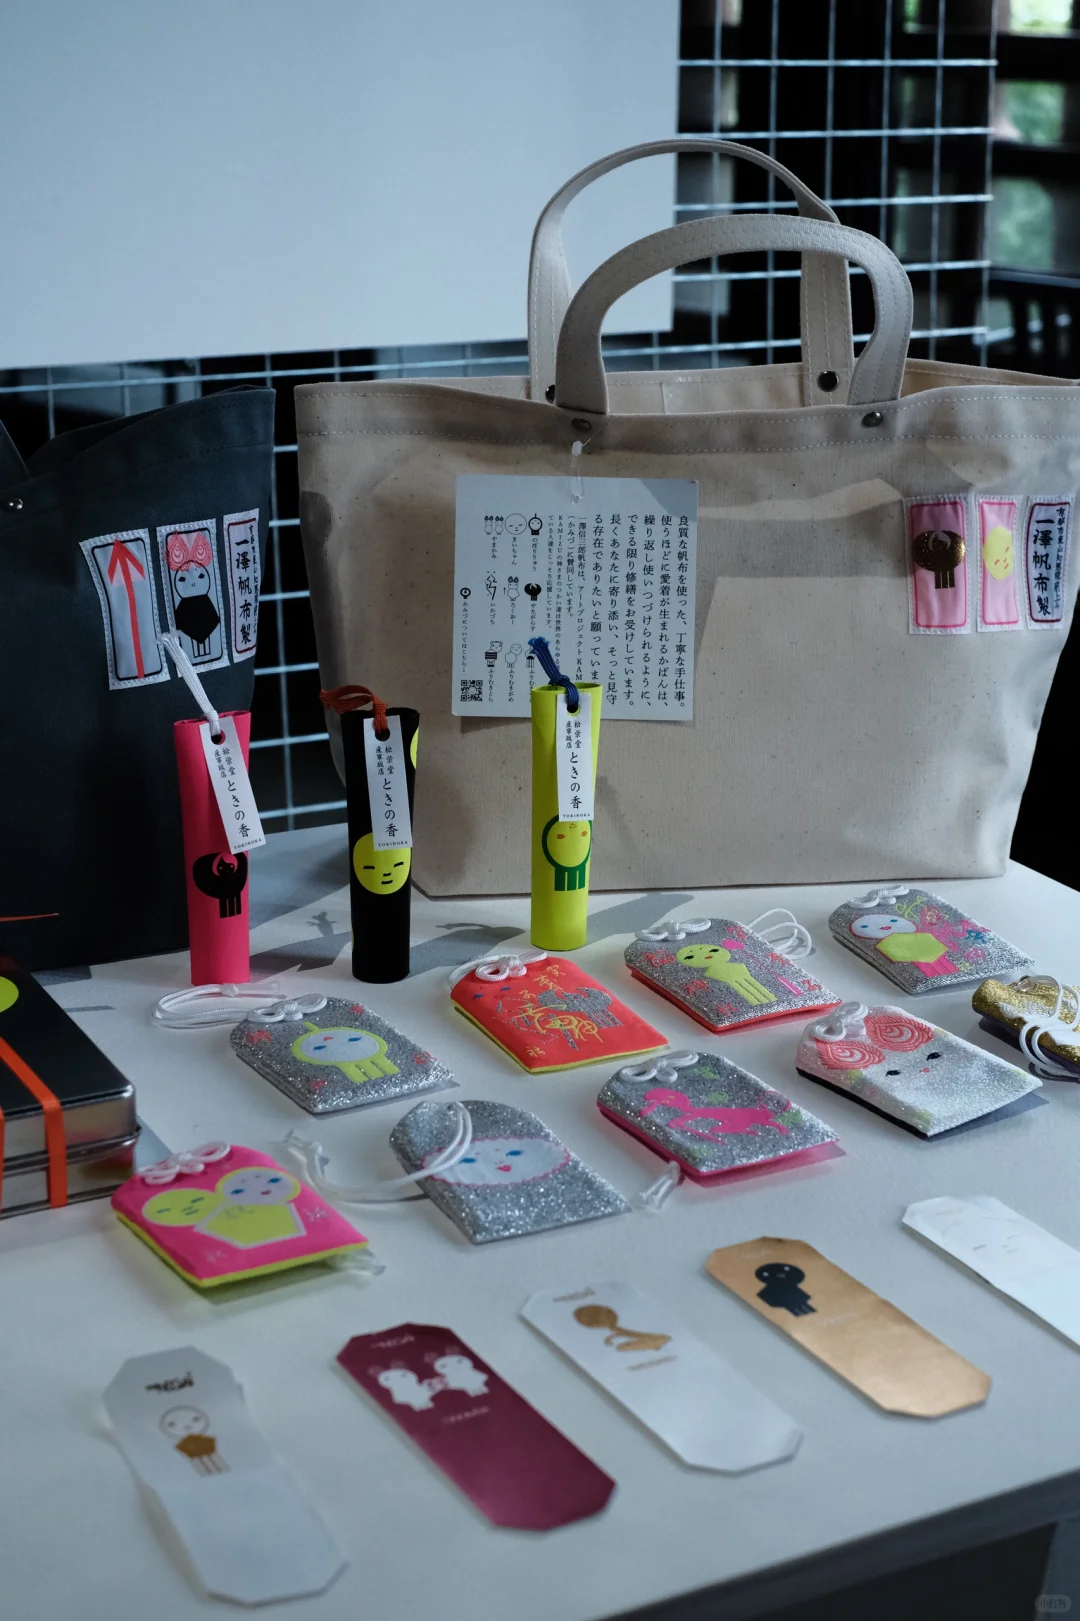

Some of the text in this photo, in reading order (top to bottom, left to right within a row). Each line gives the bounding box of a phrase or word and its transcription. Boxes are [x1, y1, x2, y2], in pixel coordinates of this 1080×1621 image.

[235, 538, 252, 645] 一澤帆布製
[554, 515, 564, 669] KAMIZUの神さまのつかい達は世界のあらゆる
[590, 514, 604, 683] る存在でありたいと願っていま
[606, 514, 621, 705] 長くあなたに寄り添い、そっと見守
[623, 515, 638, 706] できる限り修繕をお受けしています。
[640, 514, 656, 707] 繰り返し使いつづけられるように、
[657, 515, 672, 707] 使うほどに愛着が生まれるかばんは、
[673, 515, 689, 708] 良質な帆布を使った、丁寧な手仕事。
[1032, 518, 1055, 616] 一澤帆布製
[227, 780, 250, 837] ときの香
[234, 839, 262, 850] TOKINOKA
[378, 840, 408, 848] TOKINOKA
[382, 778, 398, 837] ときの香
[570, 751, 582, 809] ときの香
